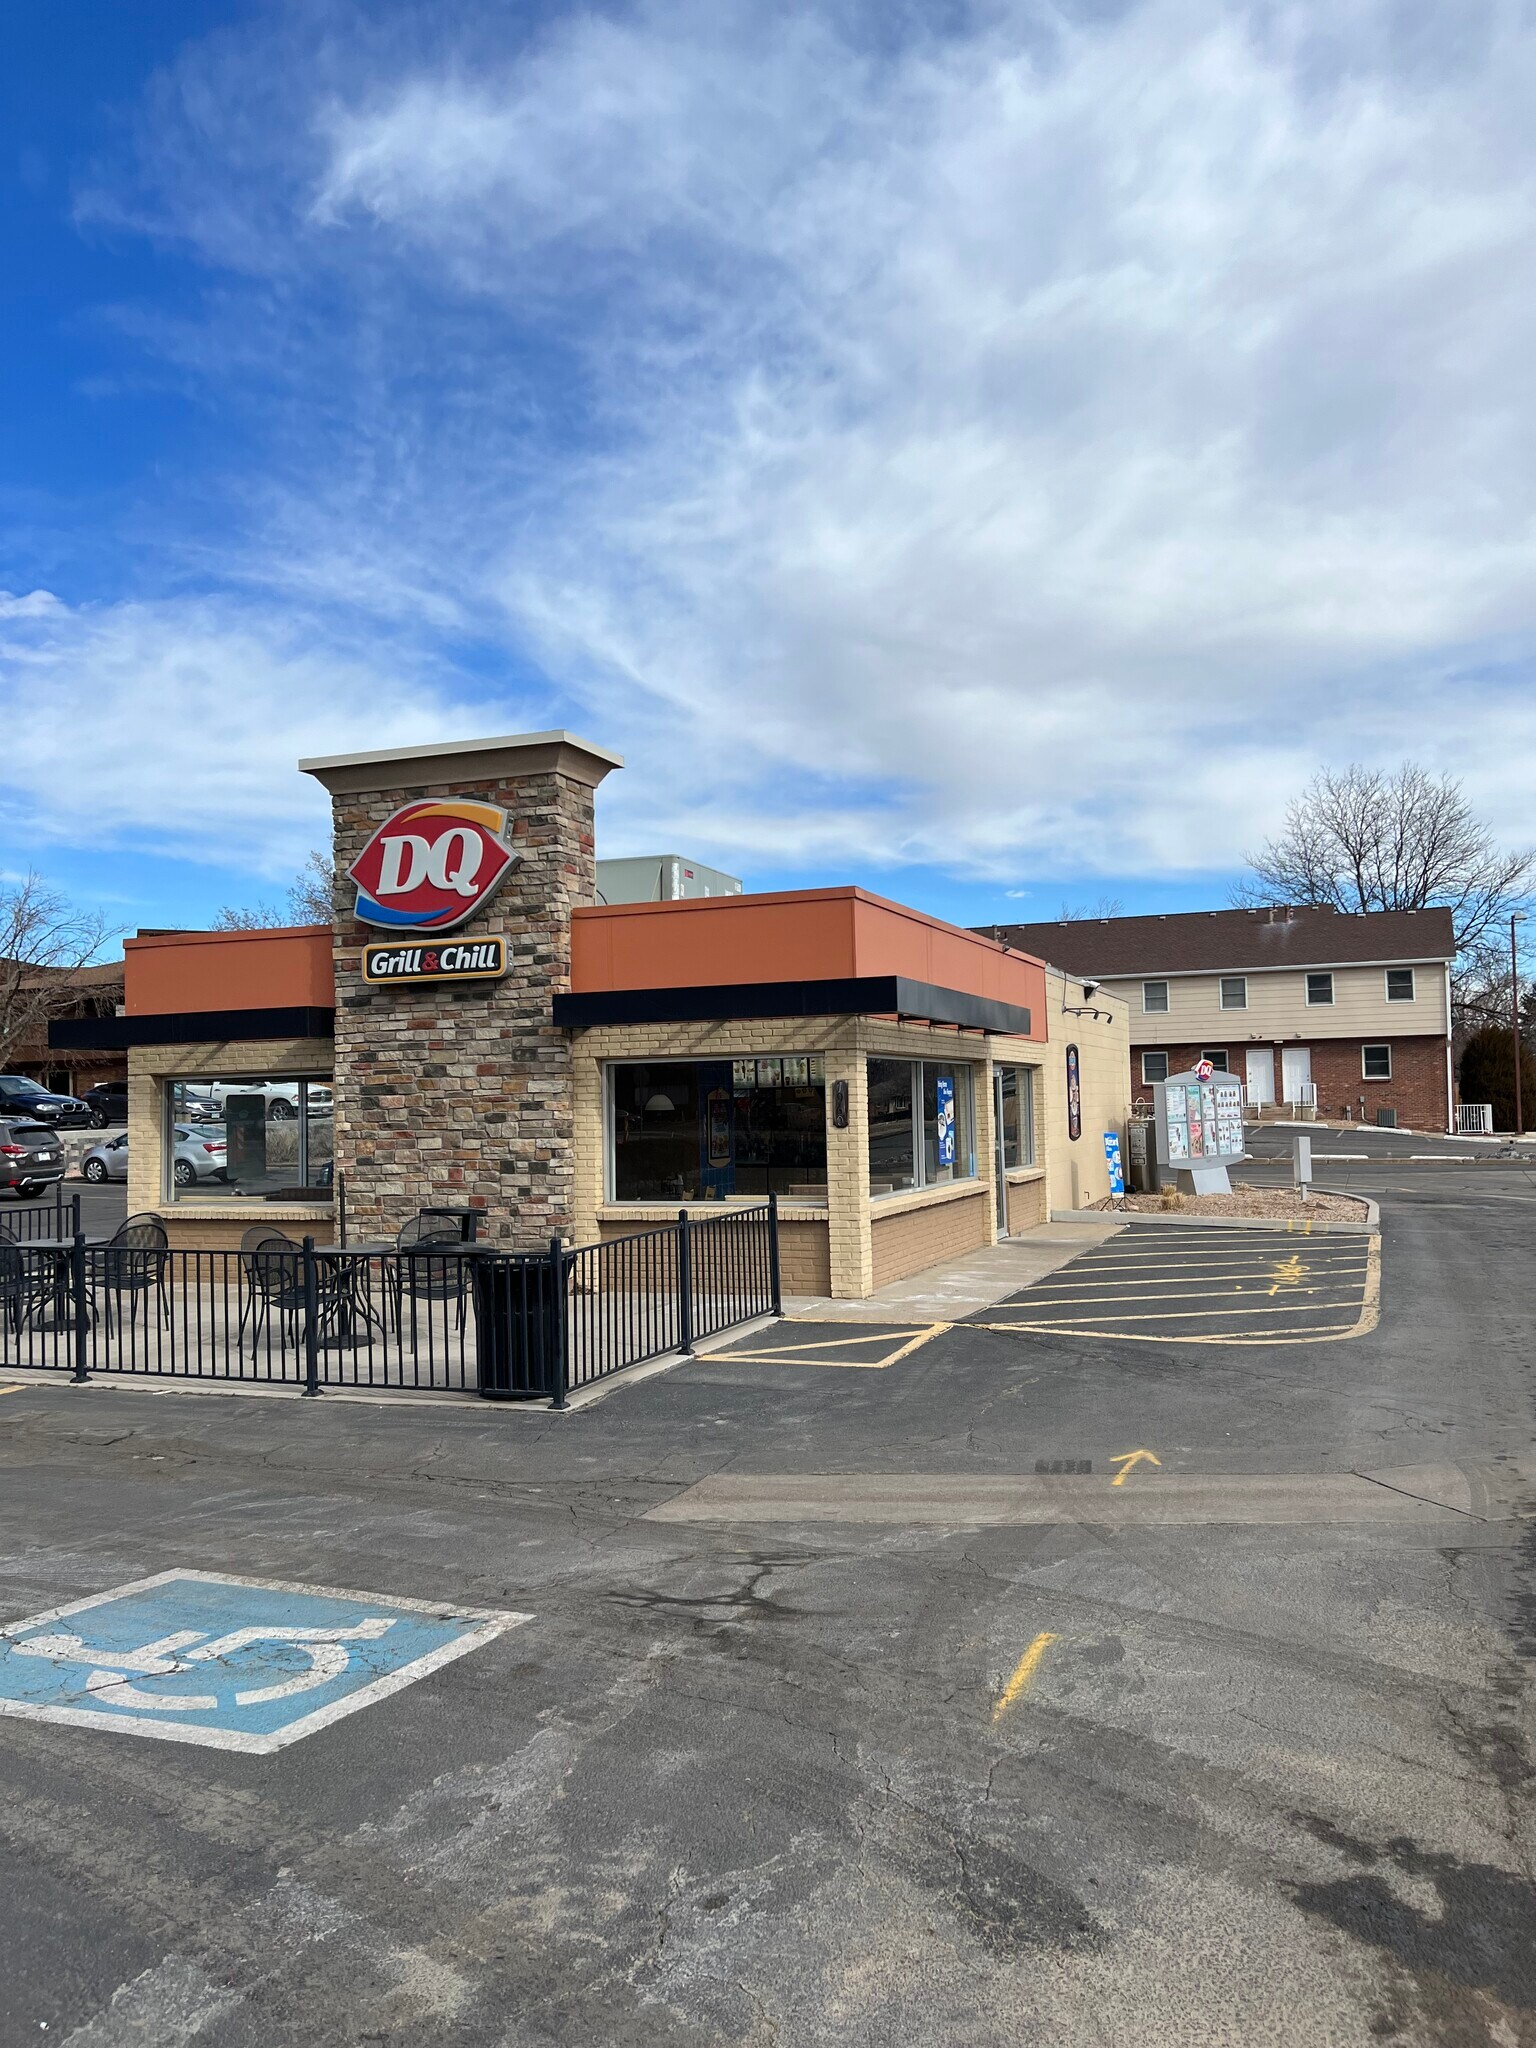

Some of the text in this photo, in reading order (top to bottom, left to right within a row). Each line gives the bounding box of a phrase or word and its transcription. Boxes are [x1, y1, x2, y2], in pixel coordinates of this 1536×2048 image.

[375, 827, 484, 897] DQ
[371, 948, 422, 975] Grill
[439, 944, 496, 970] Chill
[1200, 1065, 1211, 1076] DQ
